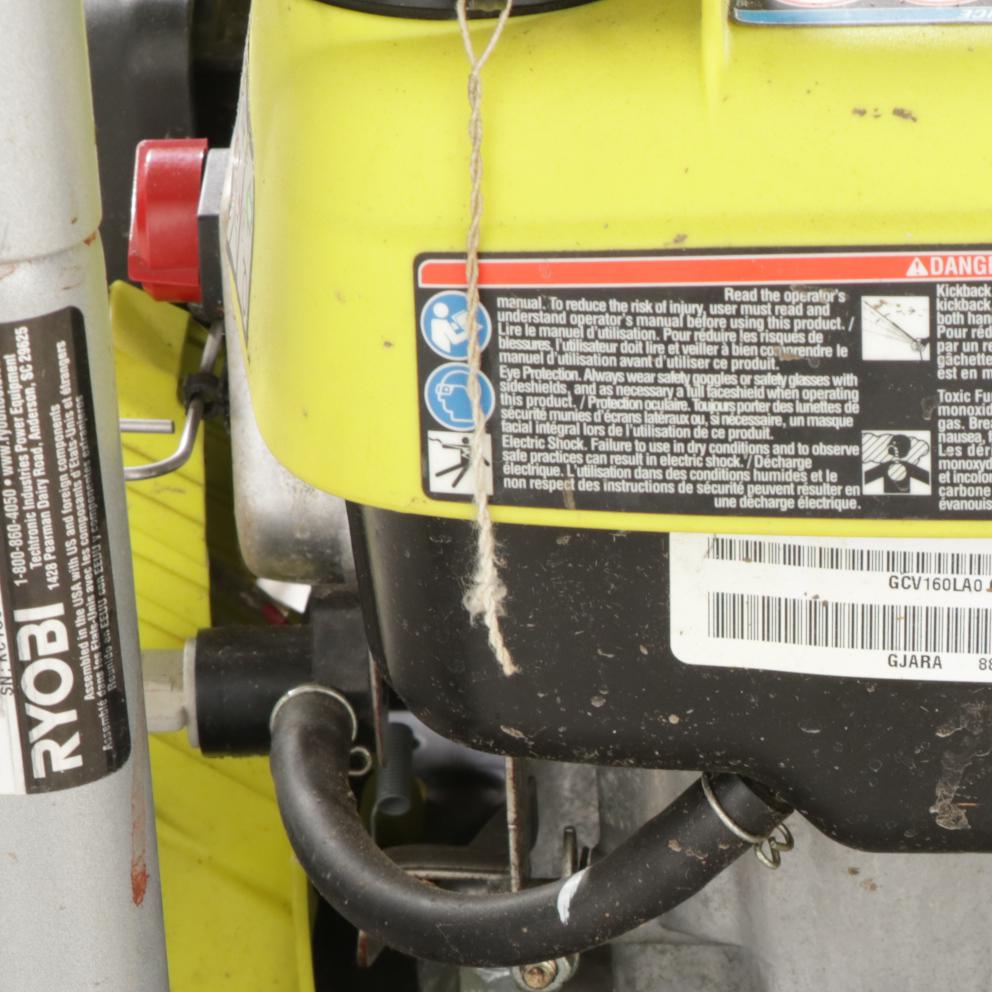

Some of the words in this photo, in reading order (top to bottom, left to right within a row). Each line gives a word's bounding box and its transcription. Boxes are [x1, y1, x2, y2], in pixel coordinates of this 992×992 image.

[497, 295, 546, 309] manual.
[549, 297, 563, 310] To
[566, 297, 606, 311] reduce
[609, 299, 628, 311] the
[631, 299, 653, 312] risk
[655, 300, 667, 313] of
[670, 301, 706, 317] injury,
[710, 304, 736, 314] user
[741, 302, 772, 315] must
[776, 302, 803, 315] read
[807, 303, 830, 315] and
[724, 287, 757, 301] Read
[760, 288, 780, 301] the
[784, 288, 845, 305] operator's
[15, 326, 30, 361] 29625
[22, 364, 33, 380] SC
[56, 341, 71, 395] étrangers
[937, 366, 958, 379] est
[961, 369, 977, 379] en
[4, 354, 24, 414] Equipment
[938, 389, 971, 402] Toxic
[26, 383, 41, 439] Anderson,
[62, 397, 73, 408] et
[14, 416, 28, 452] Power
[49, 404, 67, 471] components
[938, 419, 965, 433] gas.
[502, 436, 545, 449] Electric
[548, 437, 587, 450] Shock.
[591, 438, 631, 451] Failure
[634, 439, 646, 451] to
[650, 442, 670, 452] use
[673, 440, 684, 452] in
[688, 441, 706, 456] dry
[709, 441, 770, 453] conditions
[773, 442, 794, 454] and
[798, 442, 808, 454] to
[812, 442, 859, 454] observe
[34, 443, 46, 476] Road,
[19, 455, 34, 509] Industries
[36, 479, 50, 508] Dairy
[57, 474, 71, 513] foreign
[72, 480, 91, 545] composants
[2, 489, 28, 586] 1-800-860-4050
[40, 511, 56, 560] Pearman
[62, 517, 75, 535] and
[27, 512, 42, 569] Techtronic
[65, 541, 76, 555] US
[68, 558, 80, 581] with
[80, 549, 91, 565] les
[47, 563, 60, 590] 1428
[84, 567, 95, 592] avec
[888, 575, 983, 592] GCV160LA0
[71, 582, 83, 606] USA
[74, 609, 86, 626] the
[75, 629, 87, 638] in
[76, 642, 95, 700] Assembled
[888, 654, 942, 669] GJARA
[13, 603, 83, 778] RYOBI
